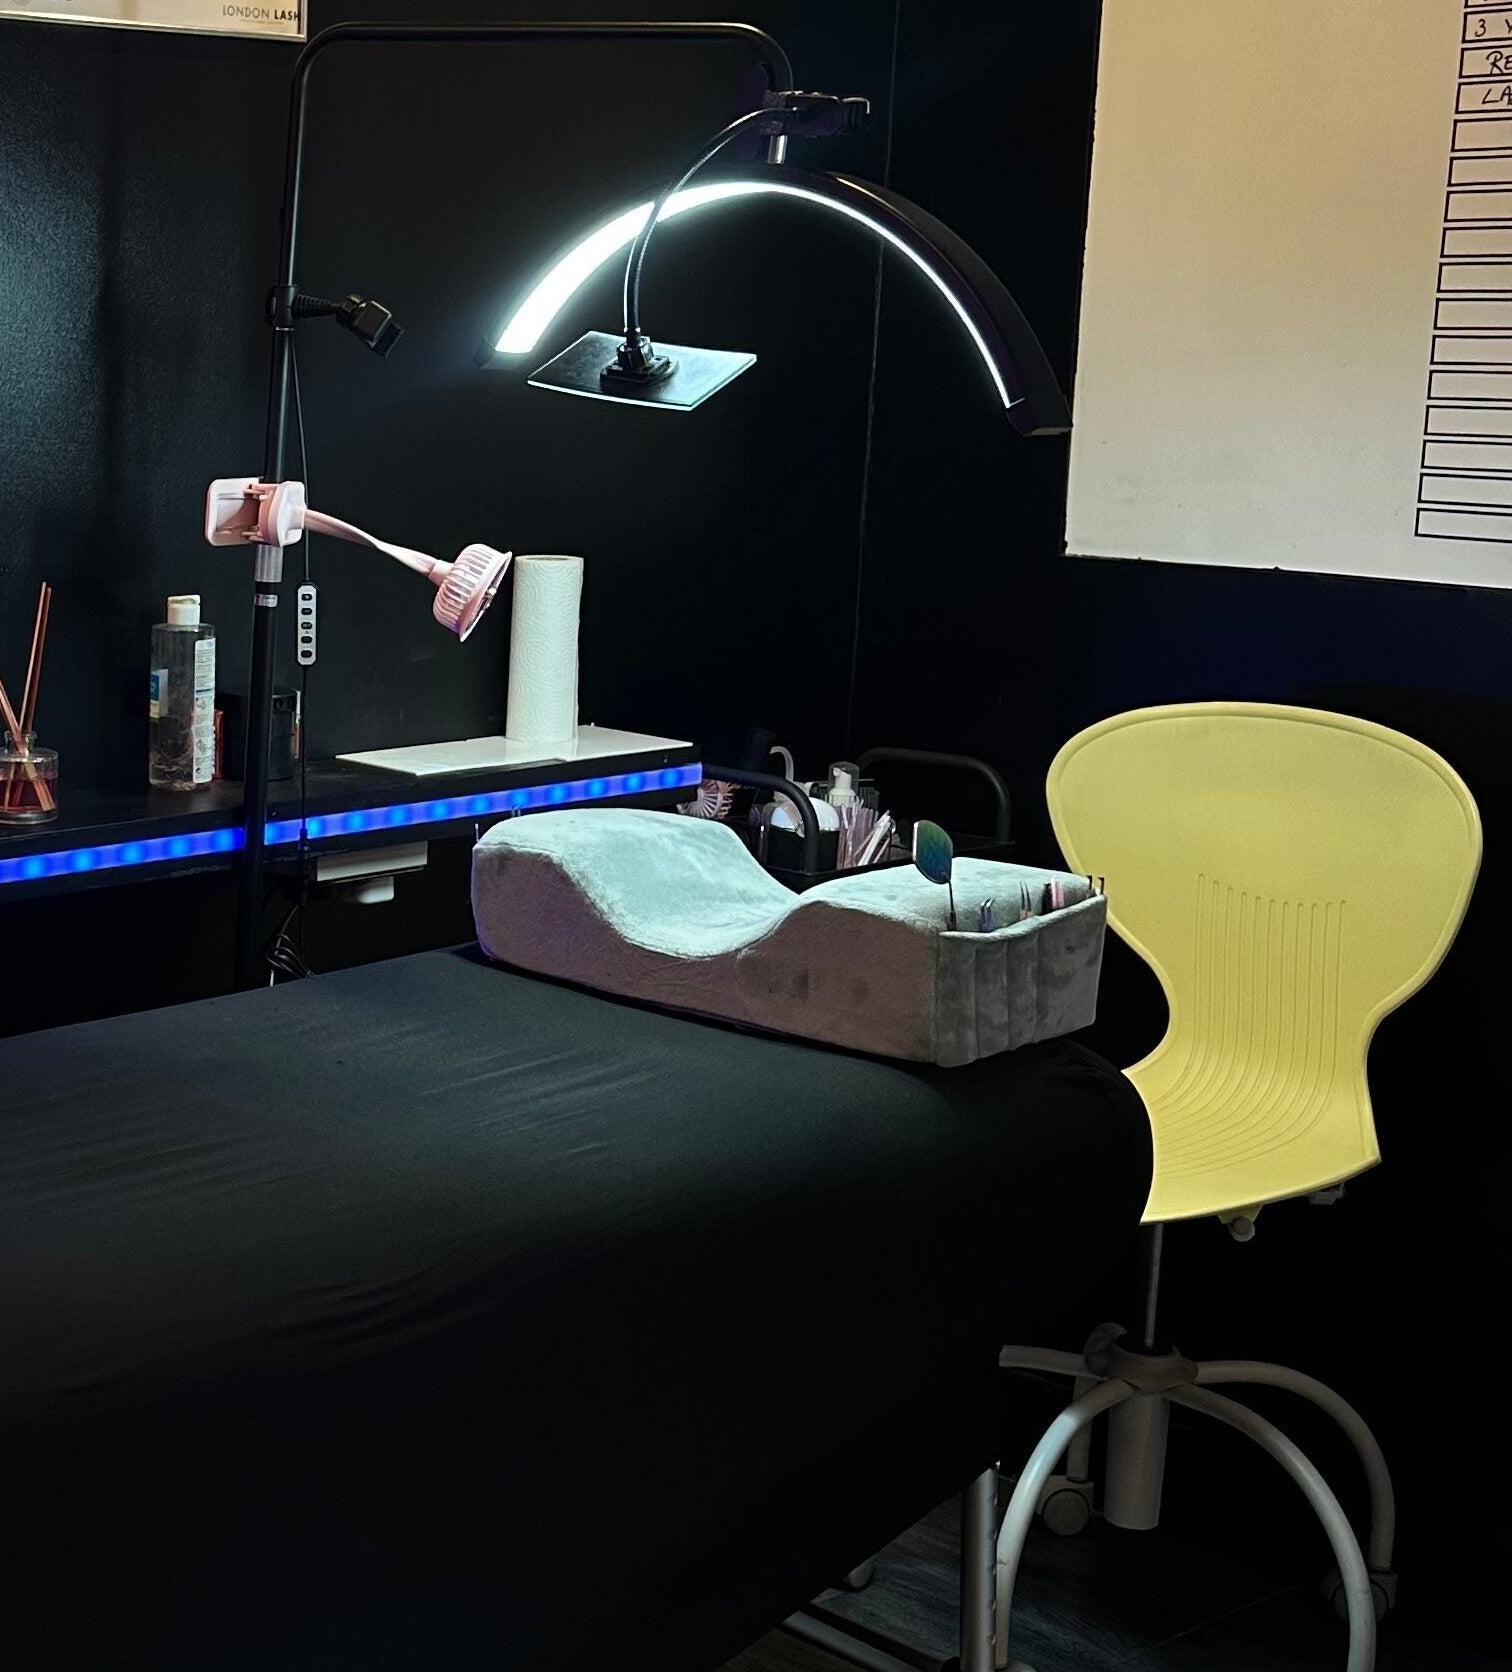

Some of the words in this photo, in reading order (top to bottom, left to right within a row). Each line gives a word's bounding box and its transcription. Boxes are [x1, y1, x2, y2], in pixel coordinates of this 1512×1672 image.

[222, 5, 270, 19] LONDON
[274, 9, 301, 21] LASH
[1474, 18, 1487, 37] 3
